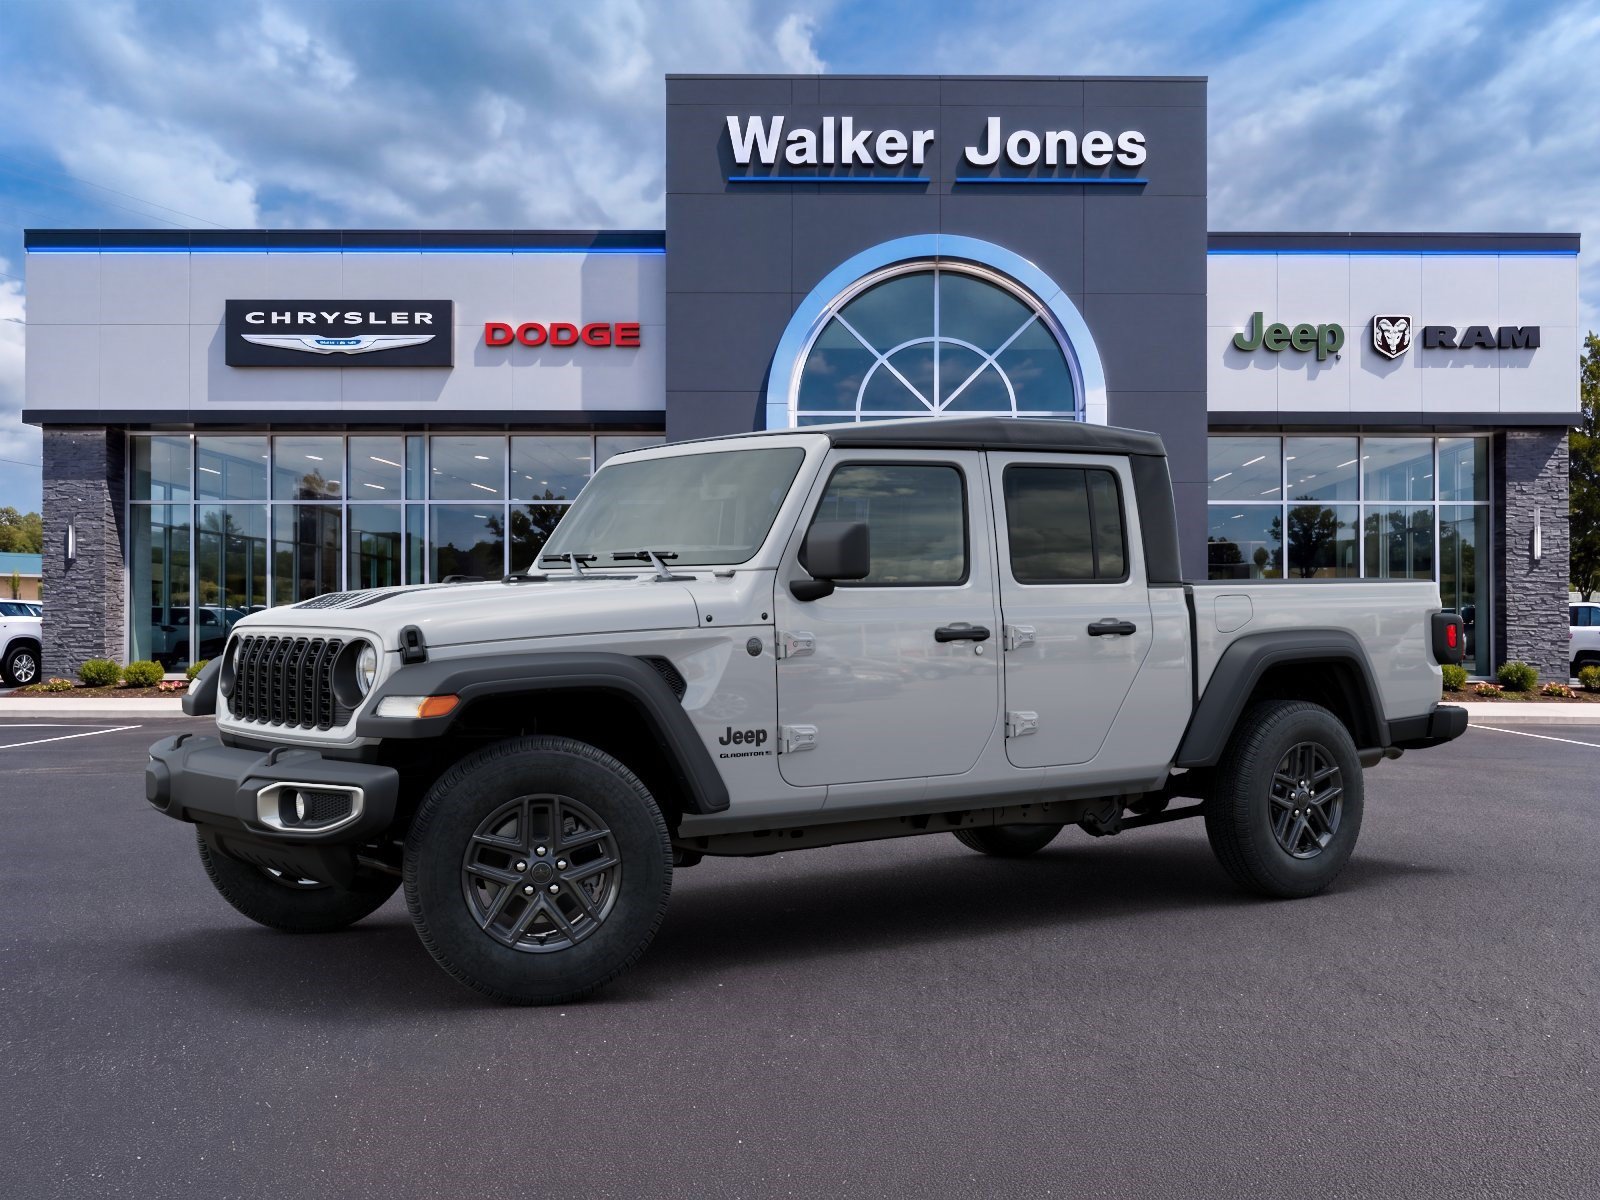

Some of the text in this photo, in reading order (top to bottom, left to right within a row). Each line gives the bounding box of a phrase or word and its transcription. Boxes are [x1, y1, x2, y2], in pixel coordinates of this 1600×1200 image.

[726, 115, 1147, 167] Walker Jones
[245, 311, 433, 325] CHRYSLER
[485, 322, 641, 348] DODGE
[1233, 311, 1345, 361] Jeep
[1424, 325, 1541, 348] RAM
[718, 726, 768, 747] Jeep
[719, 751, 765, 759] GLADIATOR
